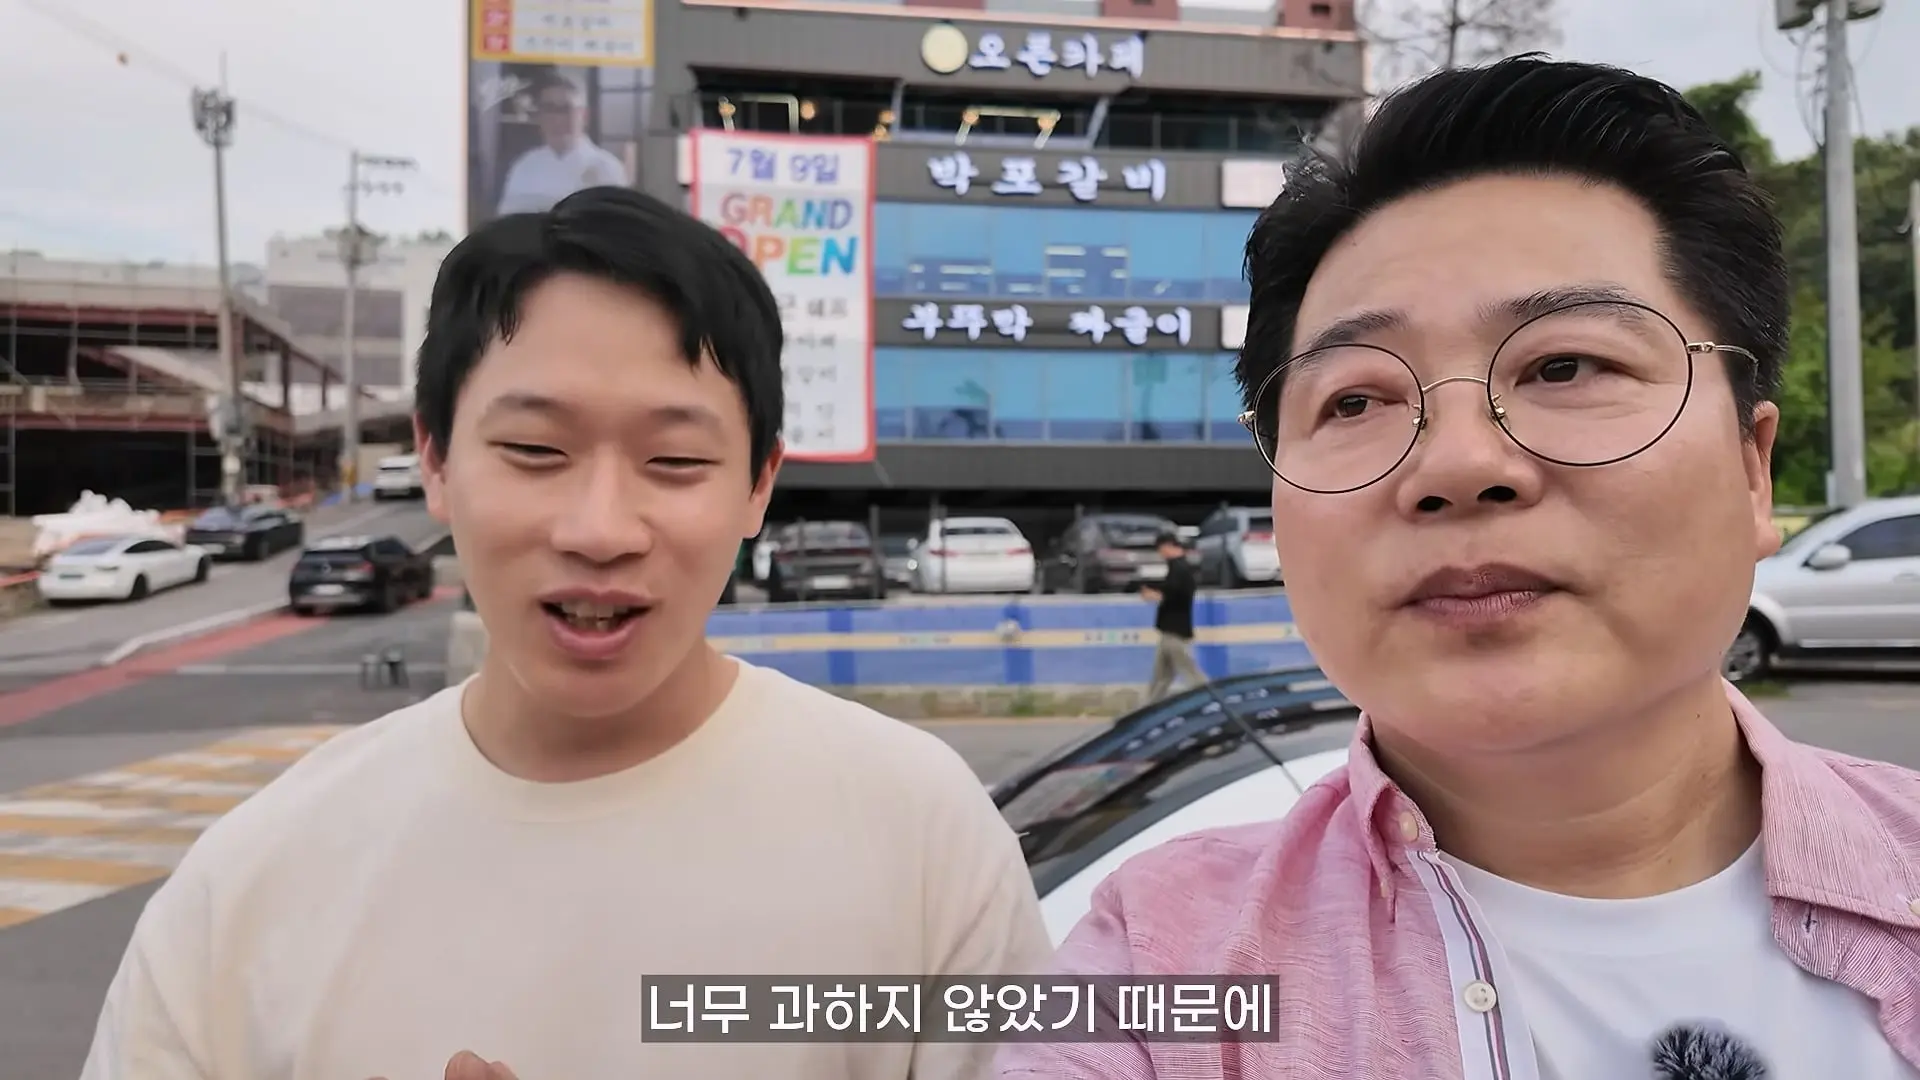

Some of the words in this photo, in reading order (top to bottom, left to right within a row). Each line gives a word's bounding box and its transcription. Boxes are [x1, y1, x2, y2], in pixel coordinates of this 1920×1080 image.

[726, 147, 776, 182] 7월
[789, 152, 840, 185] 9일
[927, 151, 1167, 202] 박포갈비
[719, 191, 854, 230] GRAND
